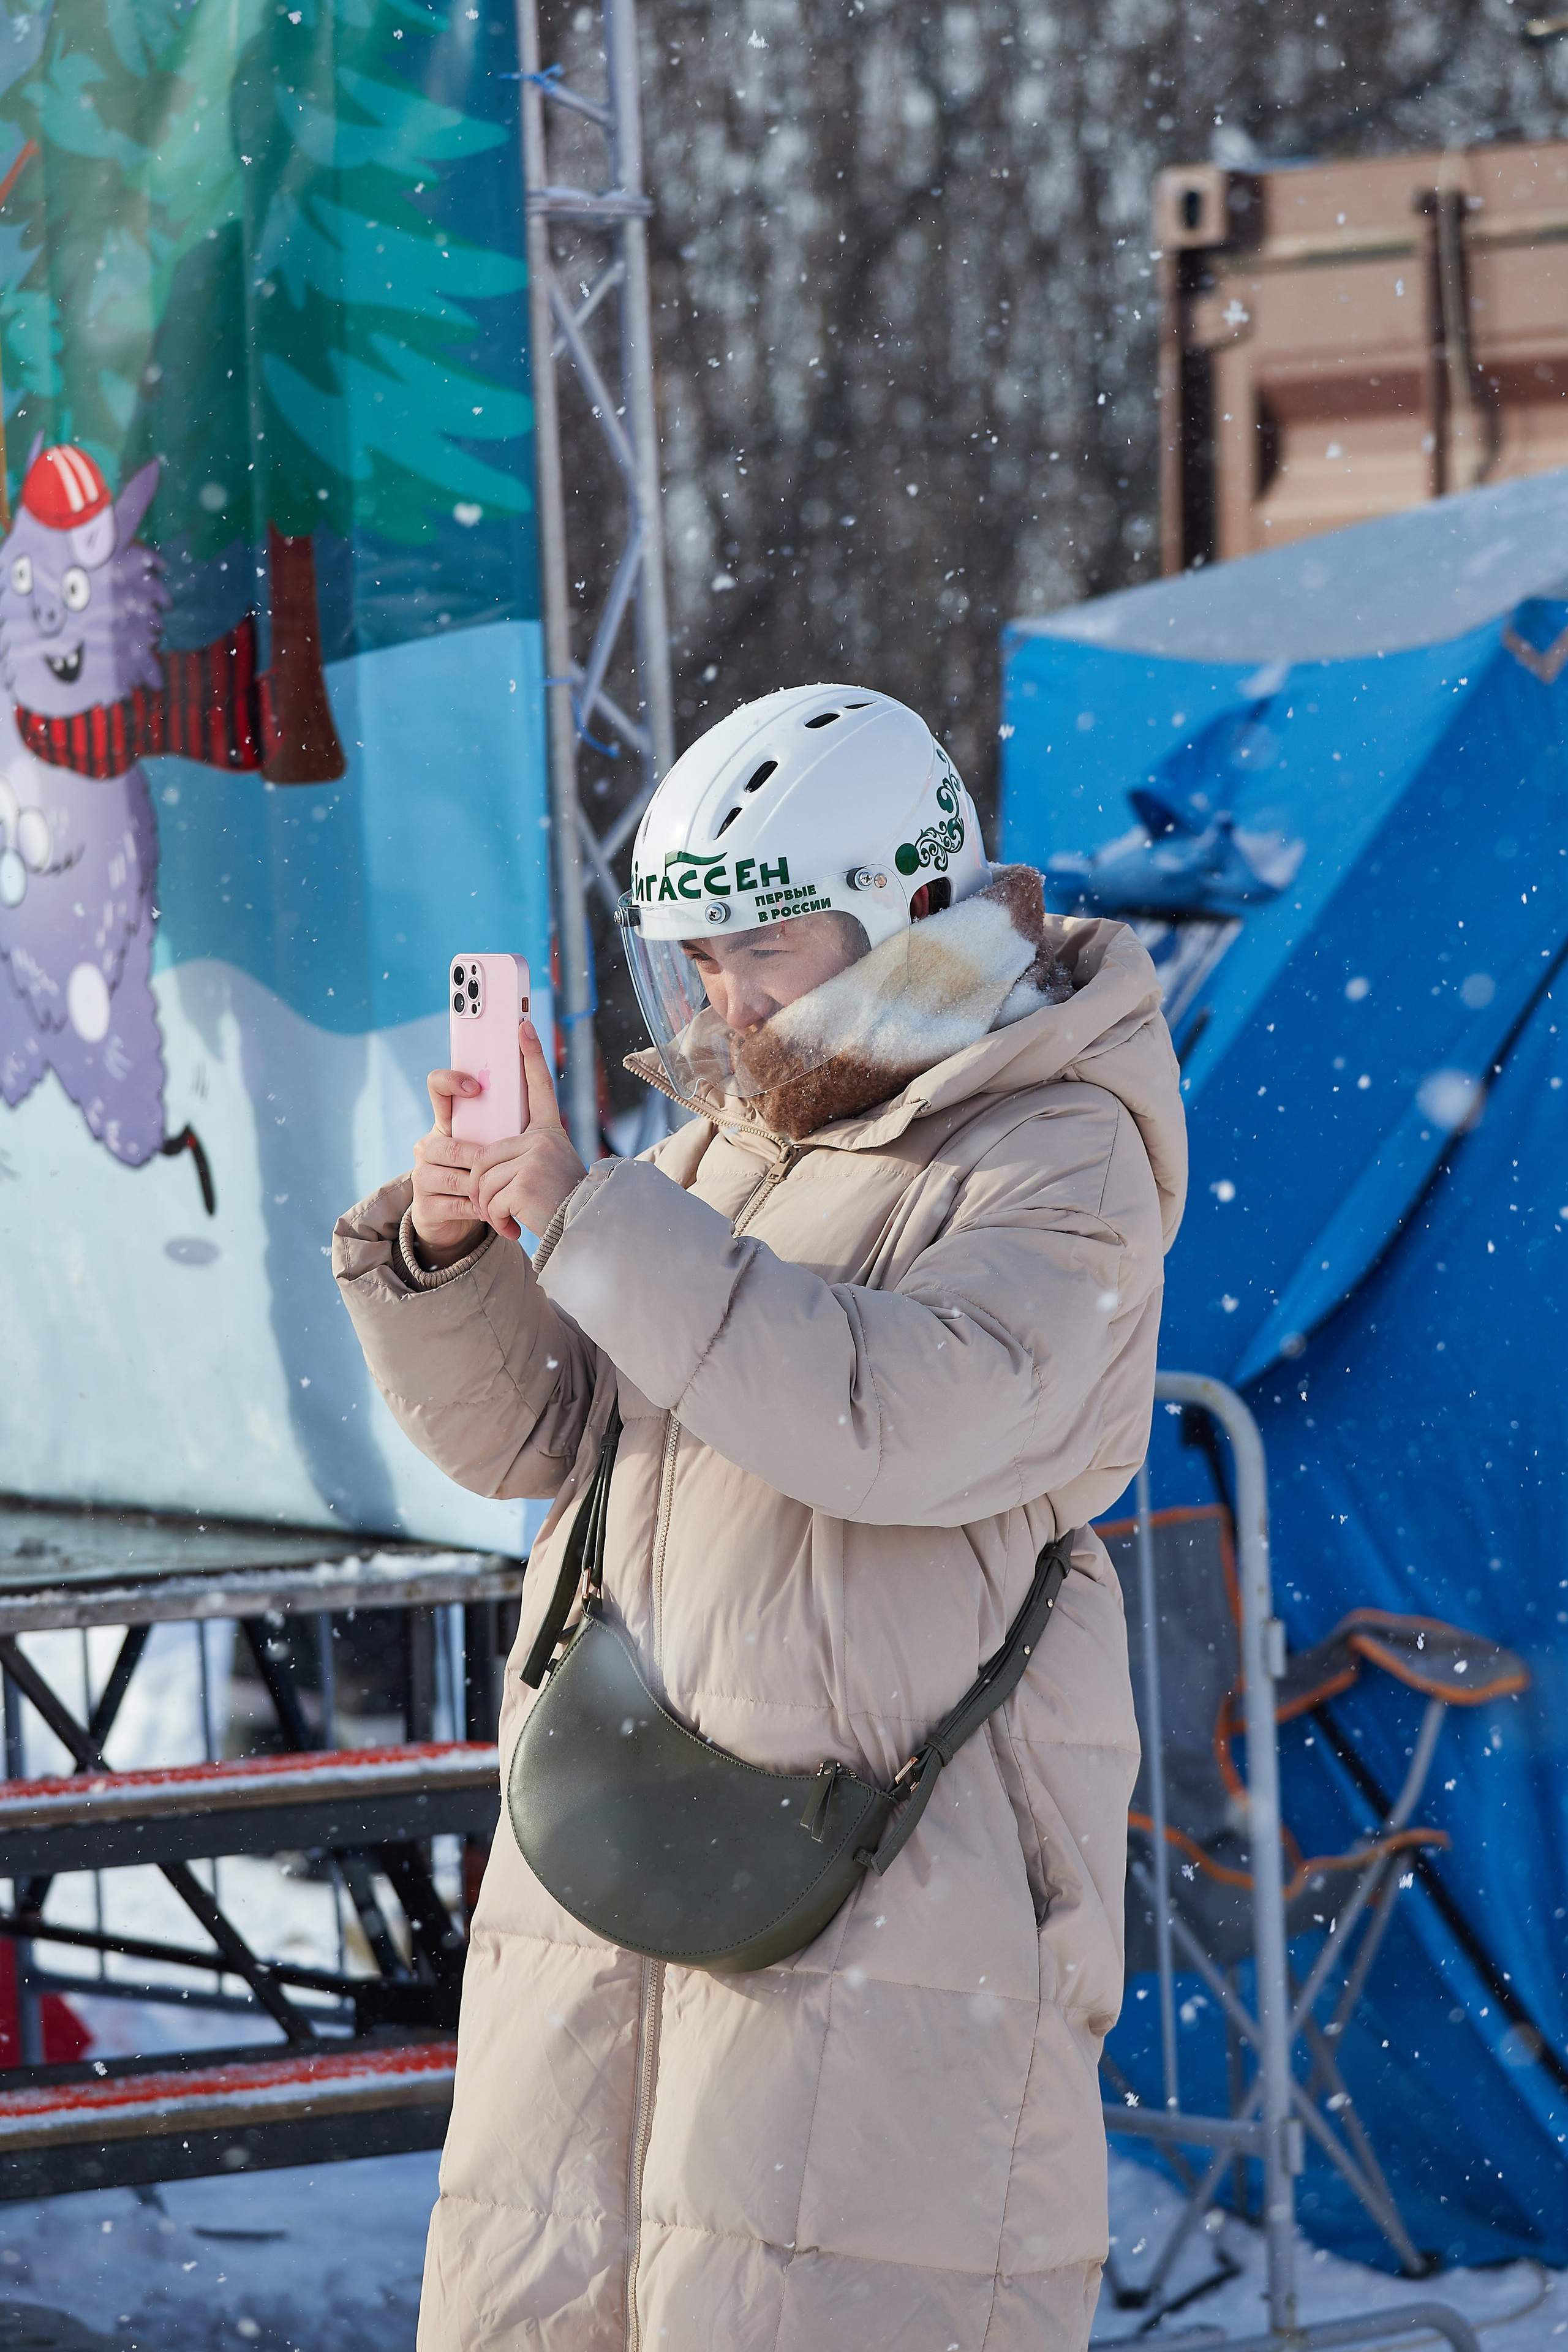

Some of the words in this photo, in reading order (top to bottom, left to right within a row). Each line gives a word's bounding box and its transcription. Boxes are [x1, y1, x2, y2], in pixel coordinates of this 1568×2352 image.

[631, 857, 790, 902] ЙГАССЕН
[755, 884, 816, 907] ПЕРВЫЕ
[758, 911, 769, 922] В
[771, 897, 831, 919] РОССИИ
